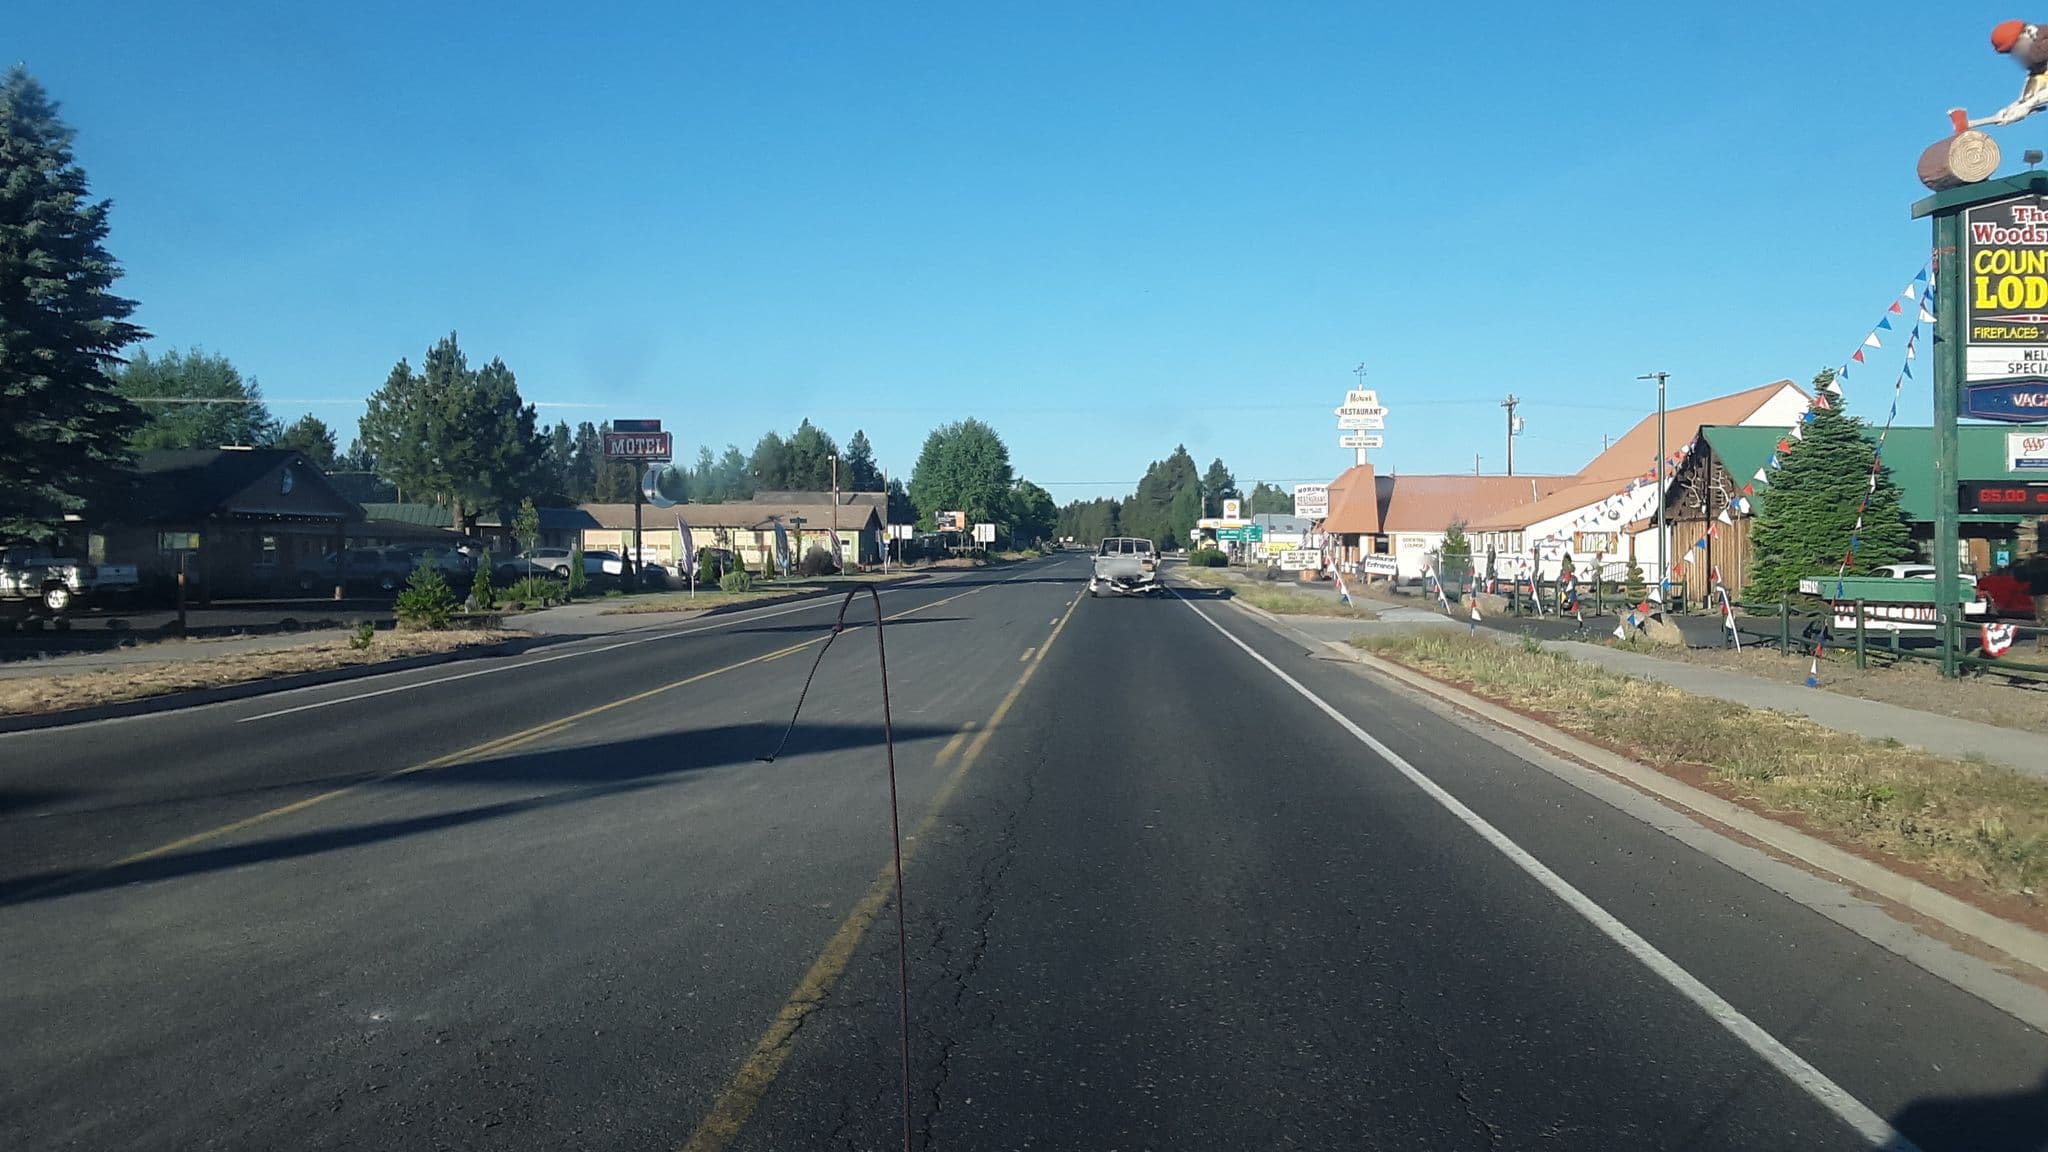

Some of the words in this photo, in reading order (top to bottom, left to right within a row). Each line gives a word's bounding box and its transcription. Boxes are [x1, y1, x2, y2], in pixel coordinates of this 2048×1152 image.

[1972, 223, 2048, 244] Woods
[1974, 327, 2039, 339] FIREPLACES
[2024, 350, 2048, 361] WEL
[1340, 408, 1382, 416] RESTAURANT
[611, 438, 665, 454] MOTEL
